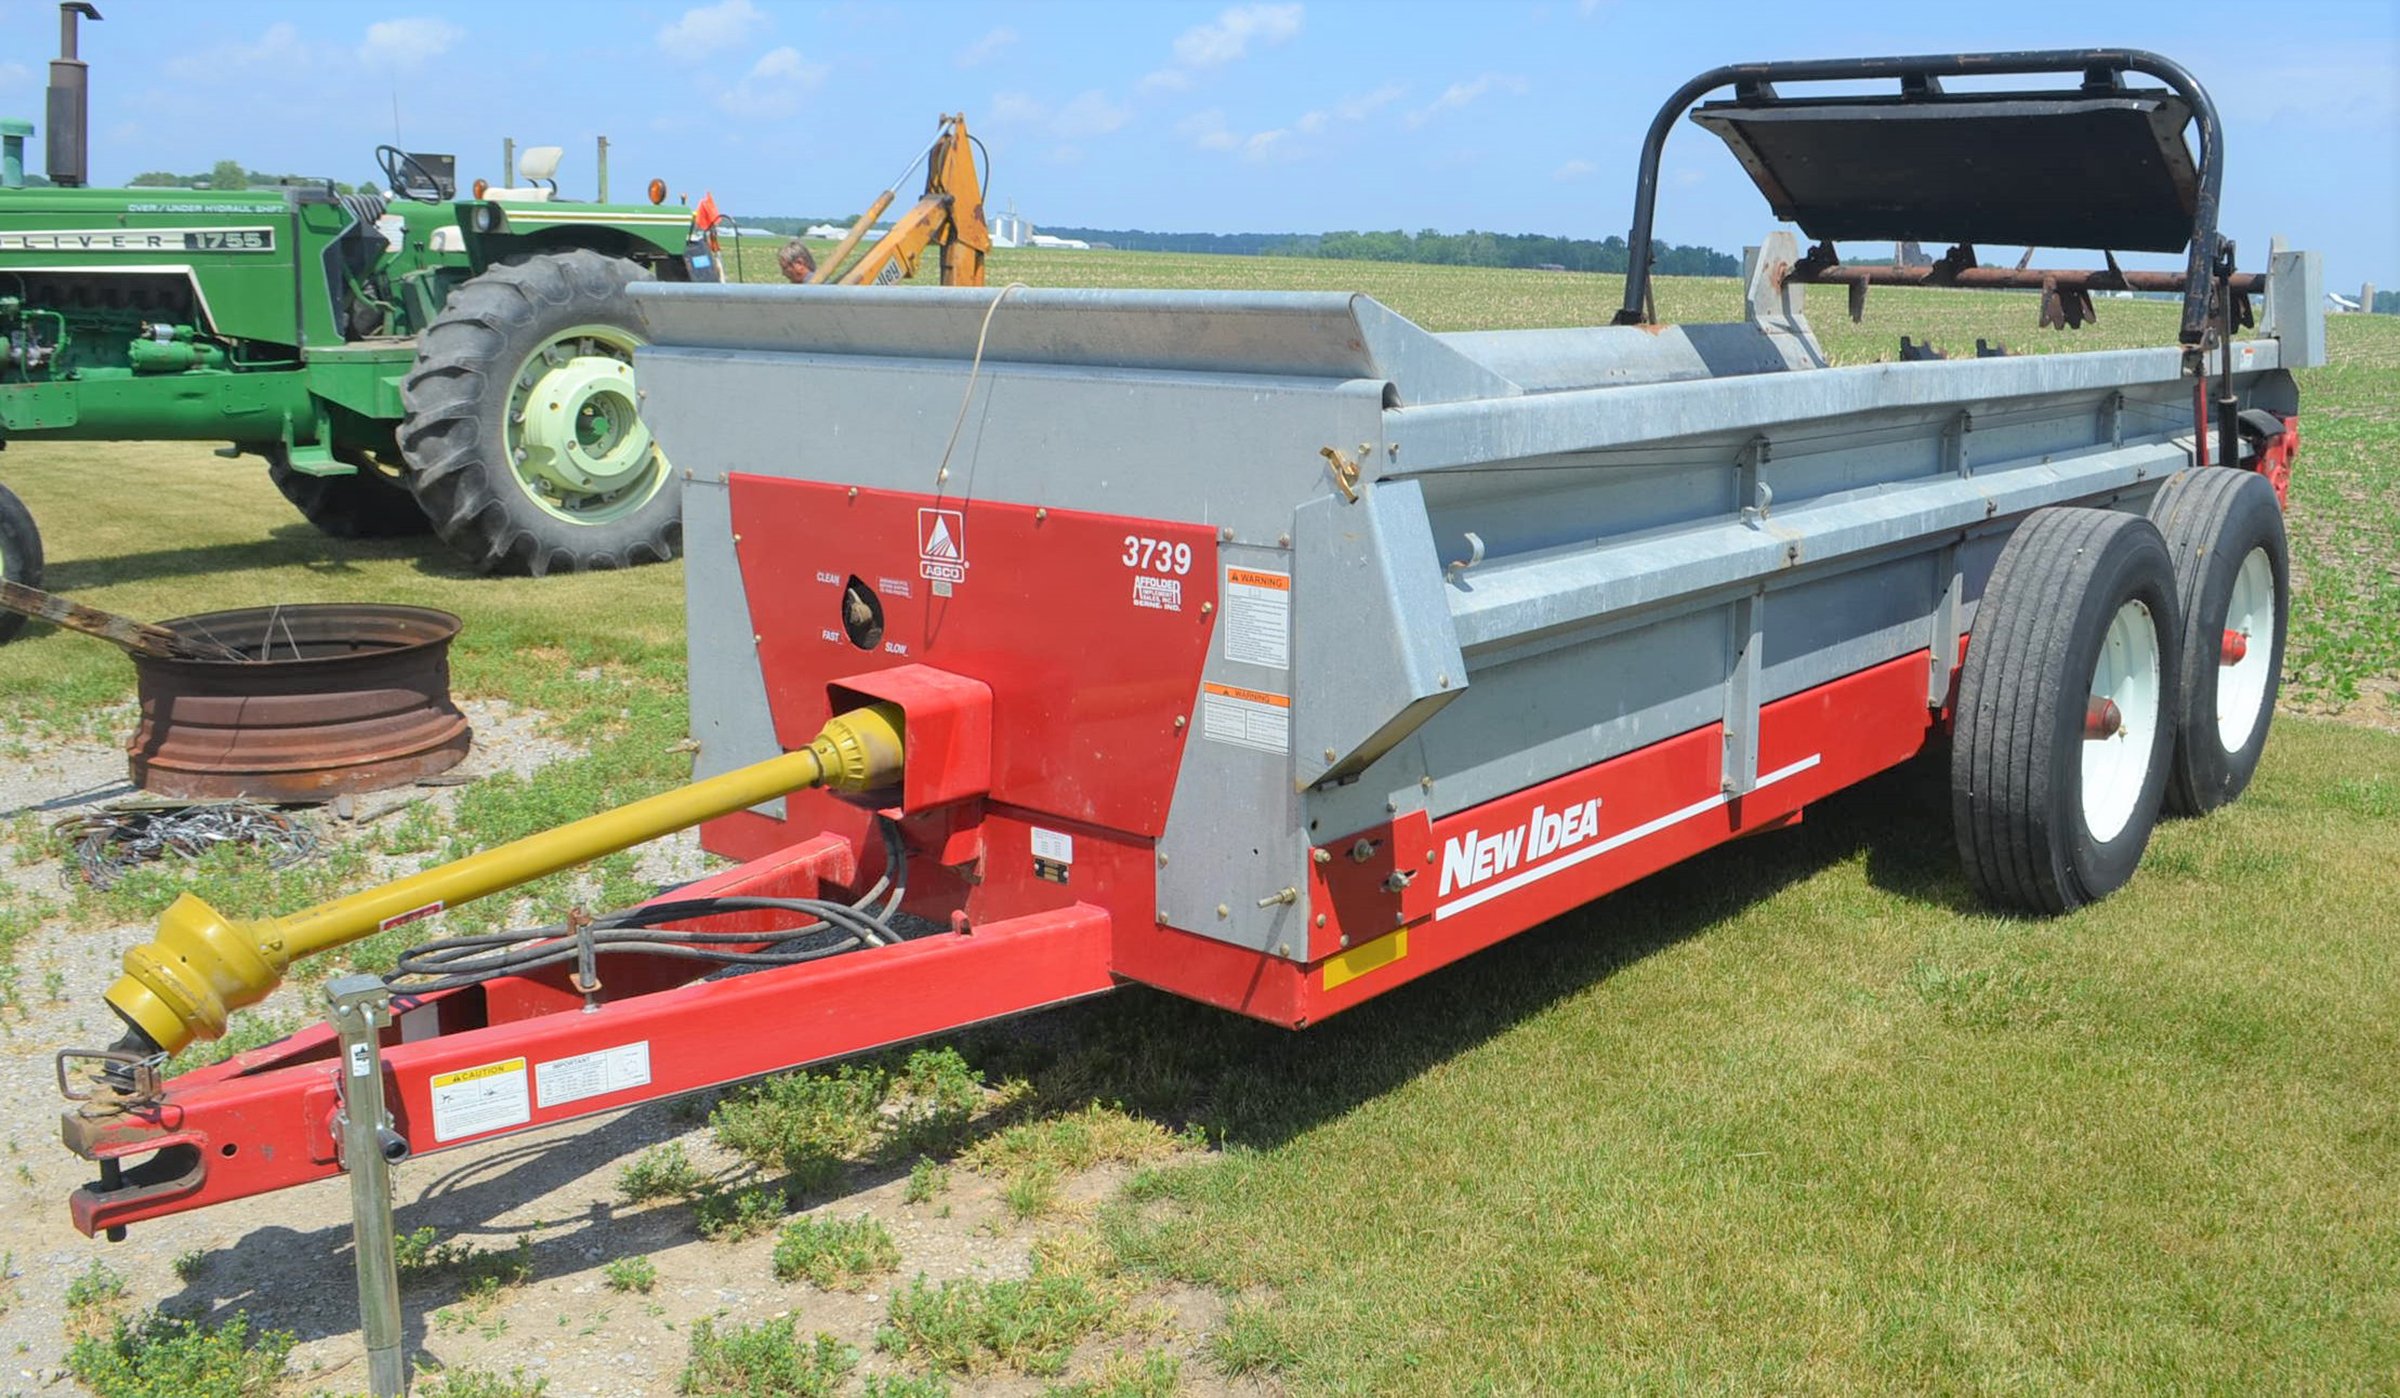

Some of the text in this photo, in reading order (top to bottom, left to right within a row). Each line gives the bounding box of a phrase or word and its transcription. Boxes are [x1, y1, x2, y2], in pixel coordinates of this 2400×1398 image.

[0, 235, 163, 249] LIVER
[195, 232, 263, 249] 1755
[1122, 535, 1192, 575] 3739
[816, 572, 840, 585] CLEAN
[925, 565, 960, 579] AGCO
[1240, 572, 1283, 588] WARNING
[822, 629, 840, 642] FAST
[885, 642, 907, 654] SLOW
[1234, 689, 1270, 705] WARNING
[1438, 824, 1526, 898] NEW
[462, 1065, 505, 1080] CAUTION
